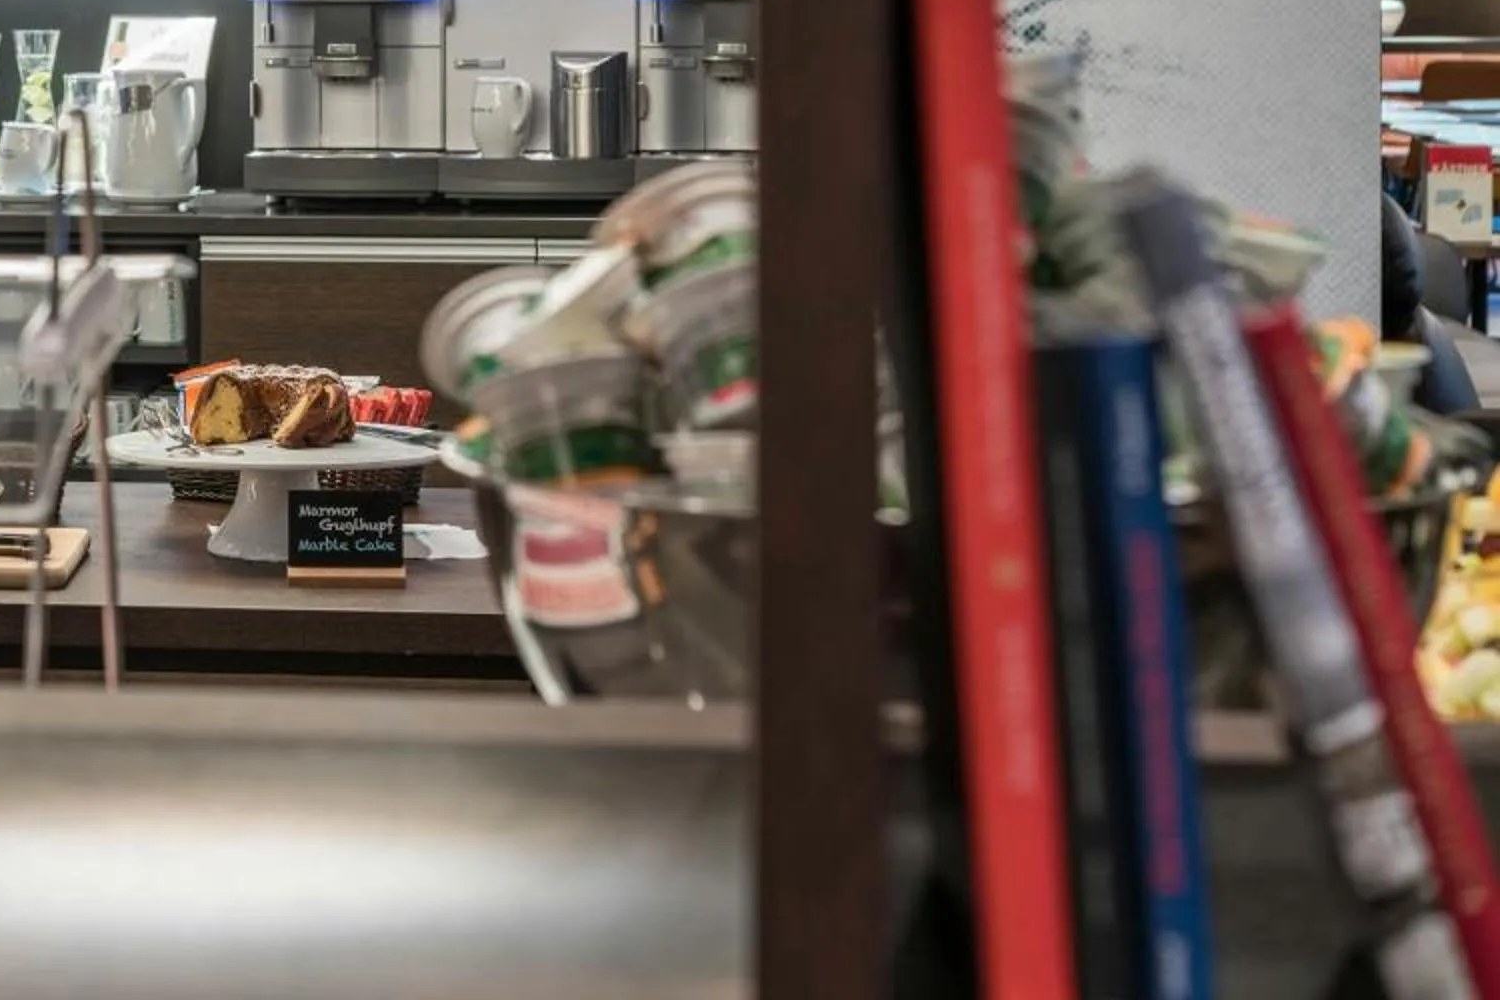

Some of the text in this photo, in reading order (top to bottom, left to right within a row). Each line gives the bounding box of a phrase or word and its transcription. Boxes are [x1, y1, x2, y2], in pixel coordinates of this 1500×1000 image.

[298, 504, 359, 517] Marmor
[319, 515, 396, 539] Guglhupf
[298, 536, 397, 552] Marble Cake
